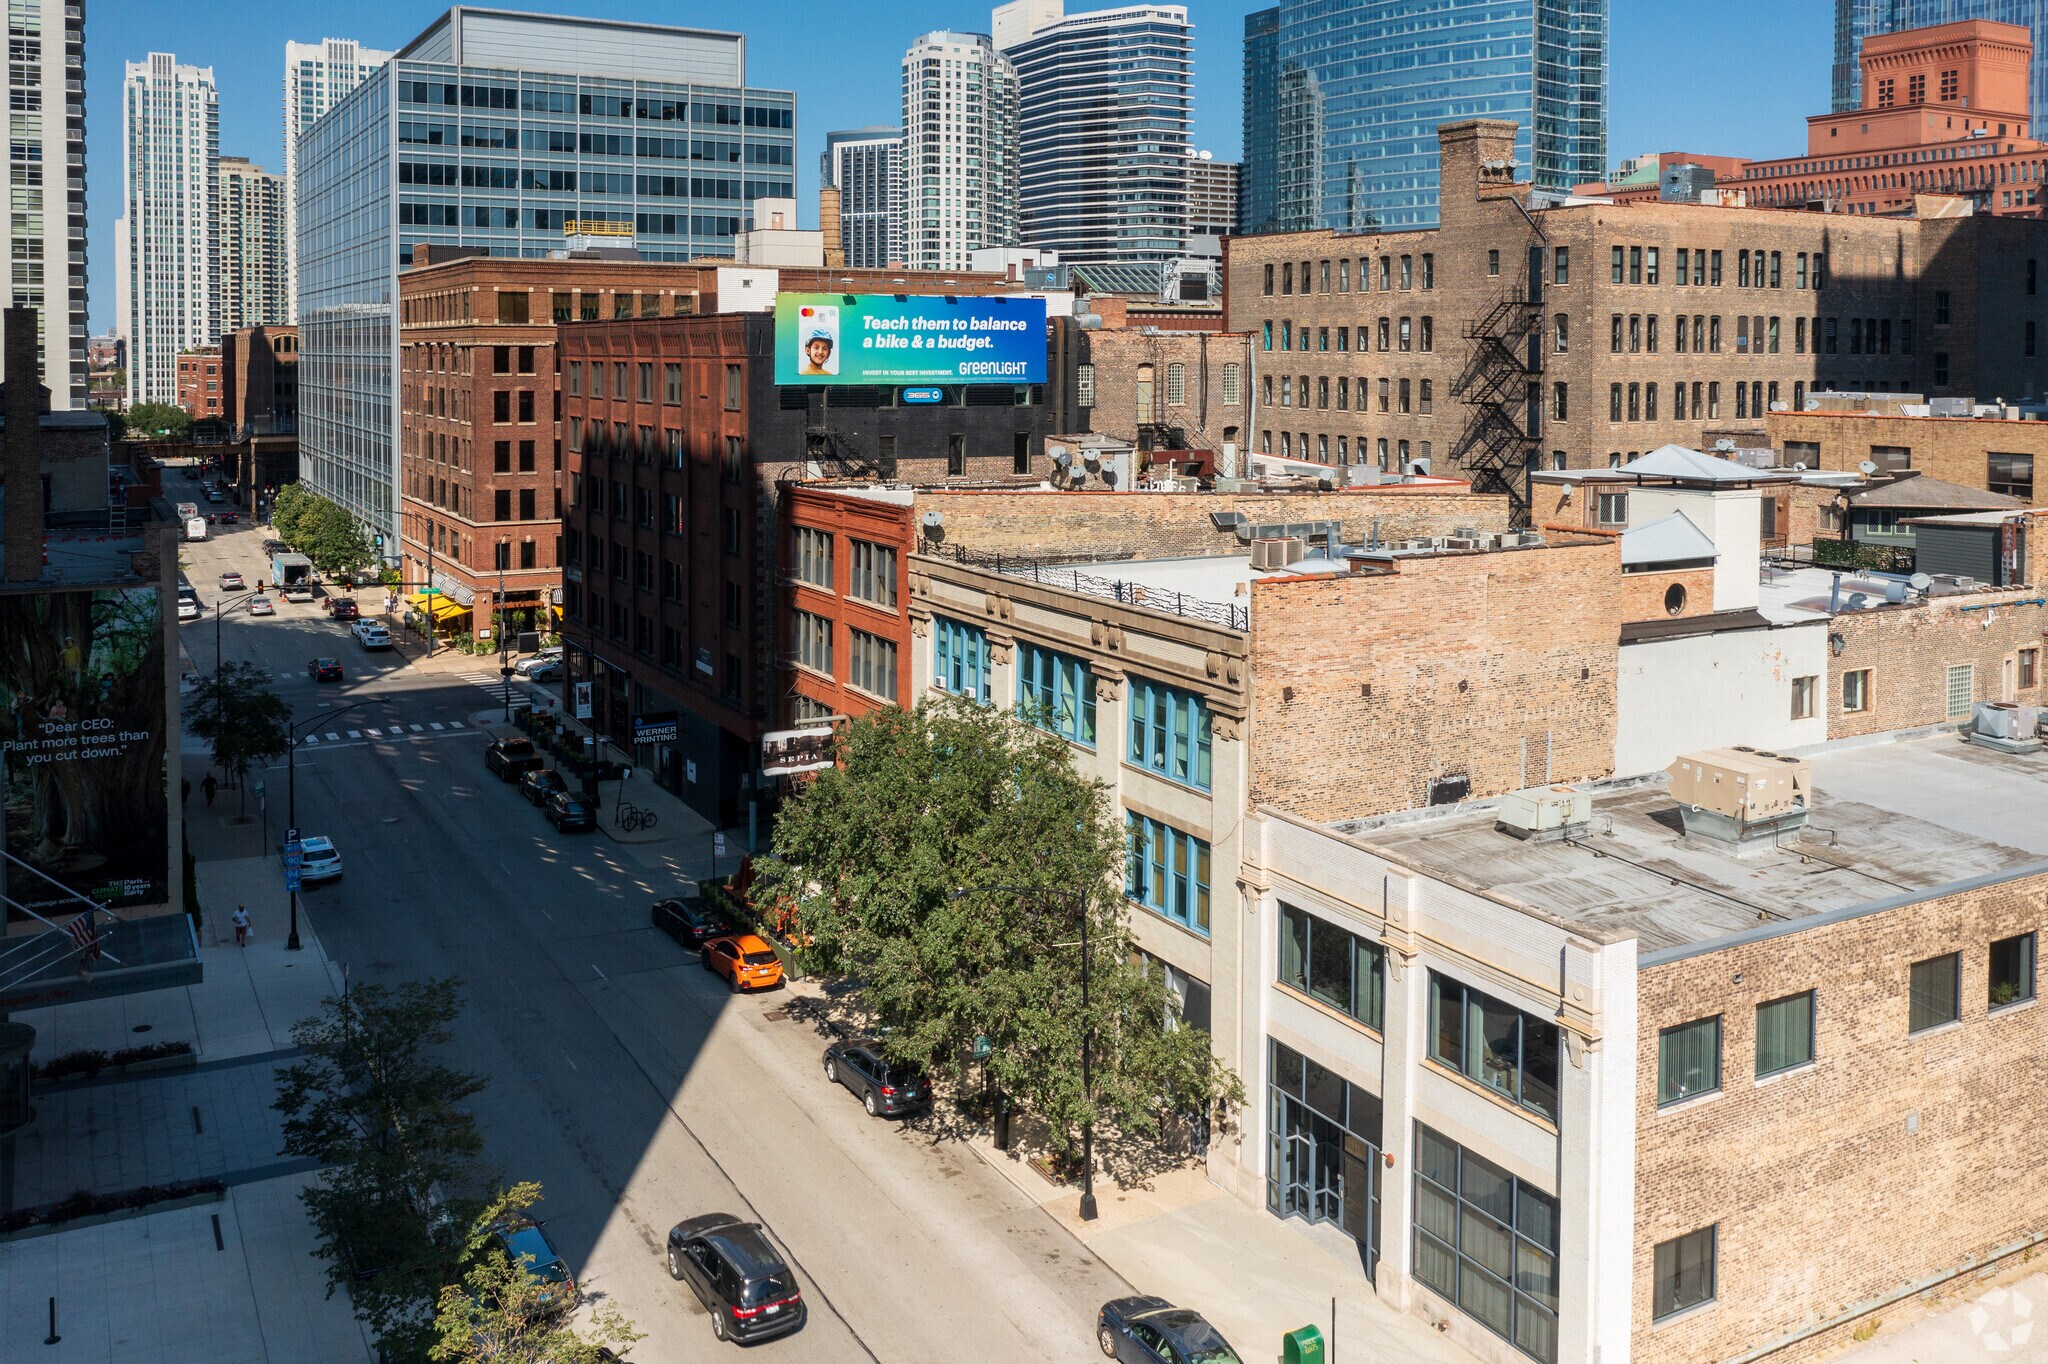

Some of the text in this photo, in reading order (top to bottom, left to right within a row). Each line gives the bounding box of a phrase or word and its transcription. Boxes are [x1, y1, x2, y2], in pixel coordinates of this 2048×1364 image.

[863, 315, 1027, 332] Teach them to balance
[863, 334, 994, 352] a bike & a budget.
[81, 718, 115, 731] CEO:
[636, 726, 677, 737] WERNER
[3, 730, 149, 752] Plant more trees than
[633, 733, 677, 745] PRINTING
[26, 752, 52, 767] you
[55, 750, 78, 761] cut
[779, 753, 818, 764] SEPIA
[288, 829, 297, 840] P
[288, 857, 299, 865] 90
[287, 871, 299, 879] 94
[131, 883, 151, 891] years
[24, 898, 58, 909] challenge
